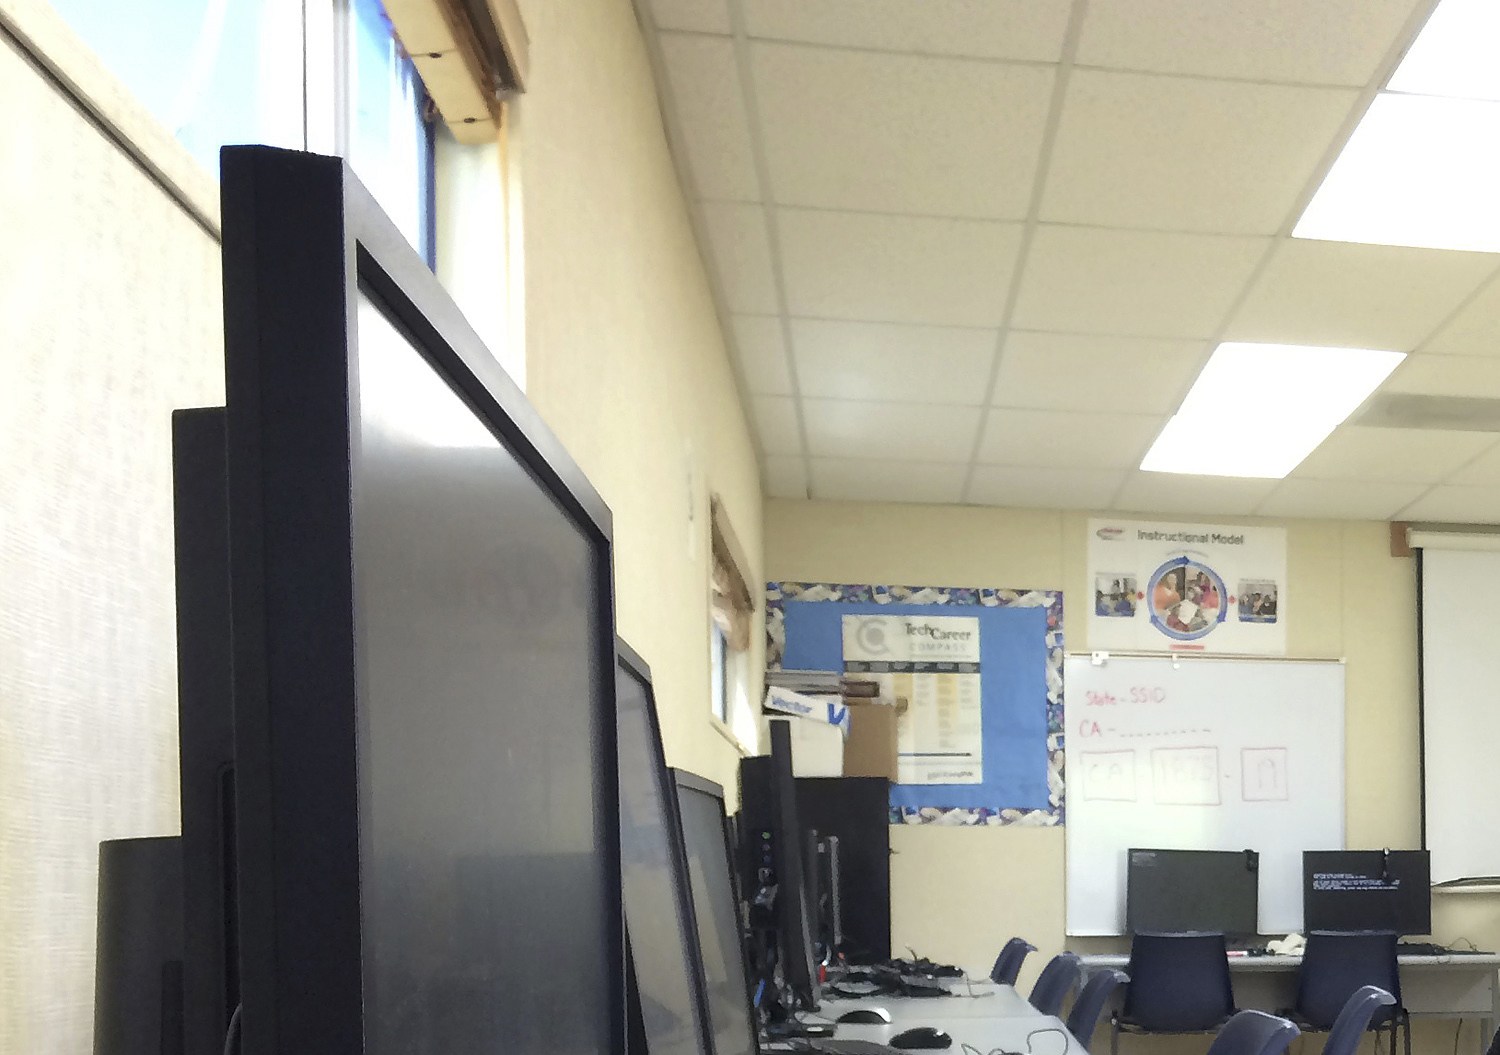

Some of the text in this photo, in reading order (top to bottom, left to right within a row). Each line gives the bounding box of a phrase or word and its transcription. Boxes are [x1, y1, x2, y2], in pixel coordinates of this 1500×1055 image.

[1137, 530, 1209, 543] Instructional
[1211, 533, 1244, 546] Model
[1129, 686, 1167, 703] SSID
[1079, 719, 1103, 738] CA
